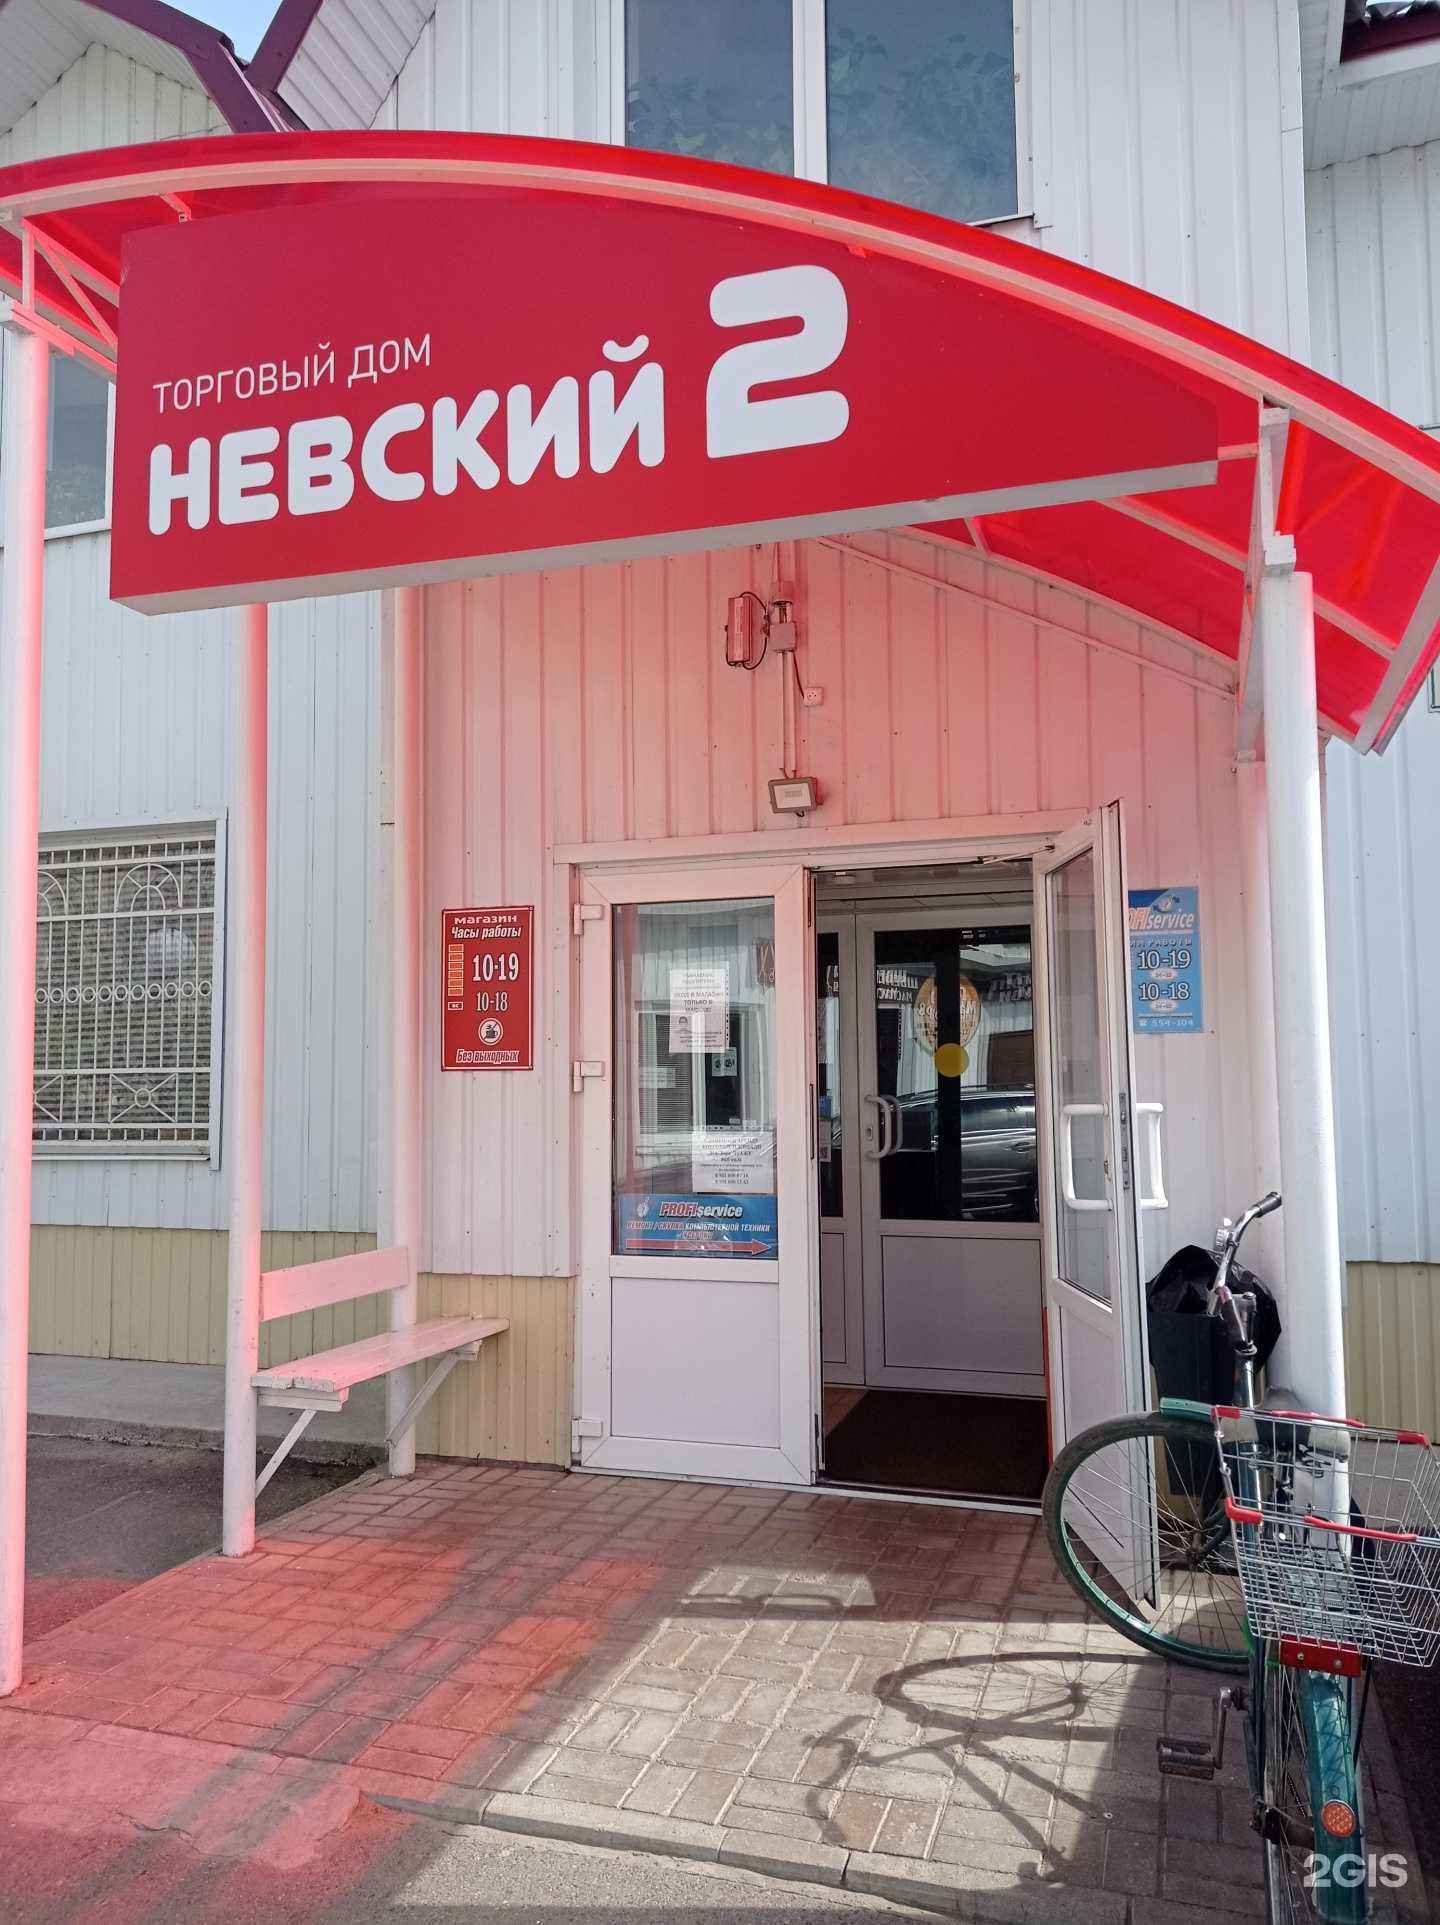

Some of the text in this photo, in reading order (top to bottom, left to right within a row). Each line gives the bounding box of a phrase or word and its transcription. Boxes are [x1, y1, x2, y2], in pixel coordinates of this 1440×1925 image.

[152, 332, 432, 414] ТОРГОВЫЙ ДОМ
[148, 264, 850, 536] НЕВСКИЙ 2
[451, 924, 522, 940] Часы работы
[472, 952, 519, 982] 10-19
[1137, 949, 1192, 970] 10-19
[476, 991, 508, 1012] 10-18
[1139, 982, 1190, 1001] 10-18
[456, 1049, 520, 1065] Без выходных
[659, 1201, 743, 1218] PROFIservice
[740, 1223, 770, 1233] ТЕХНИКИ
